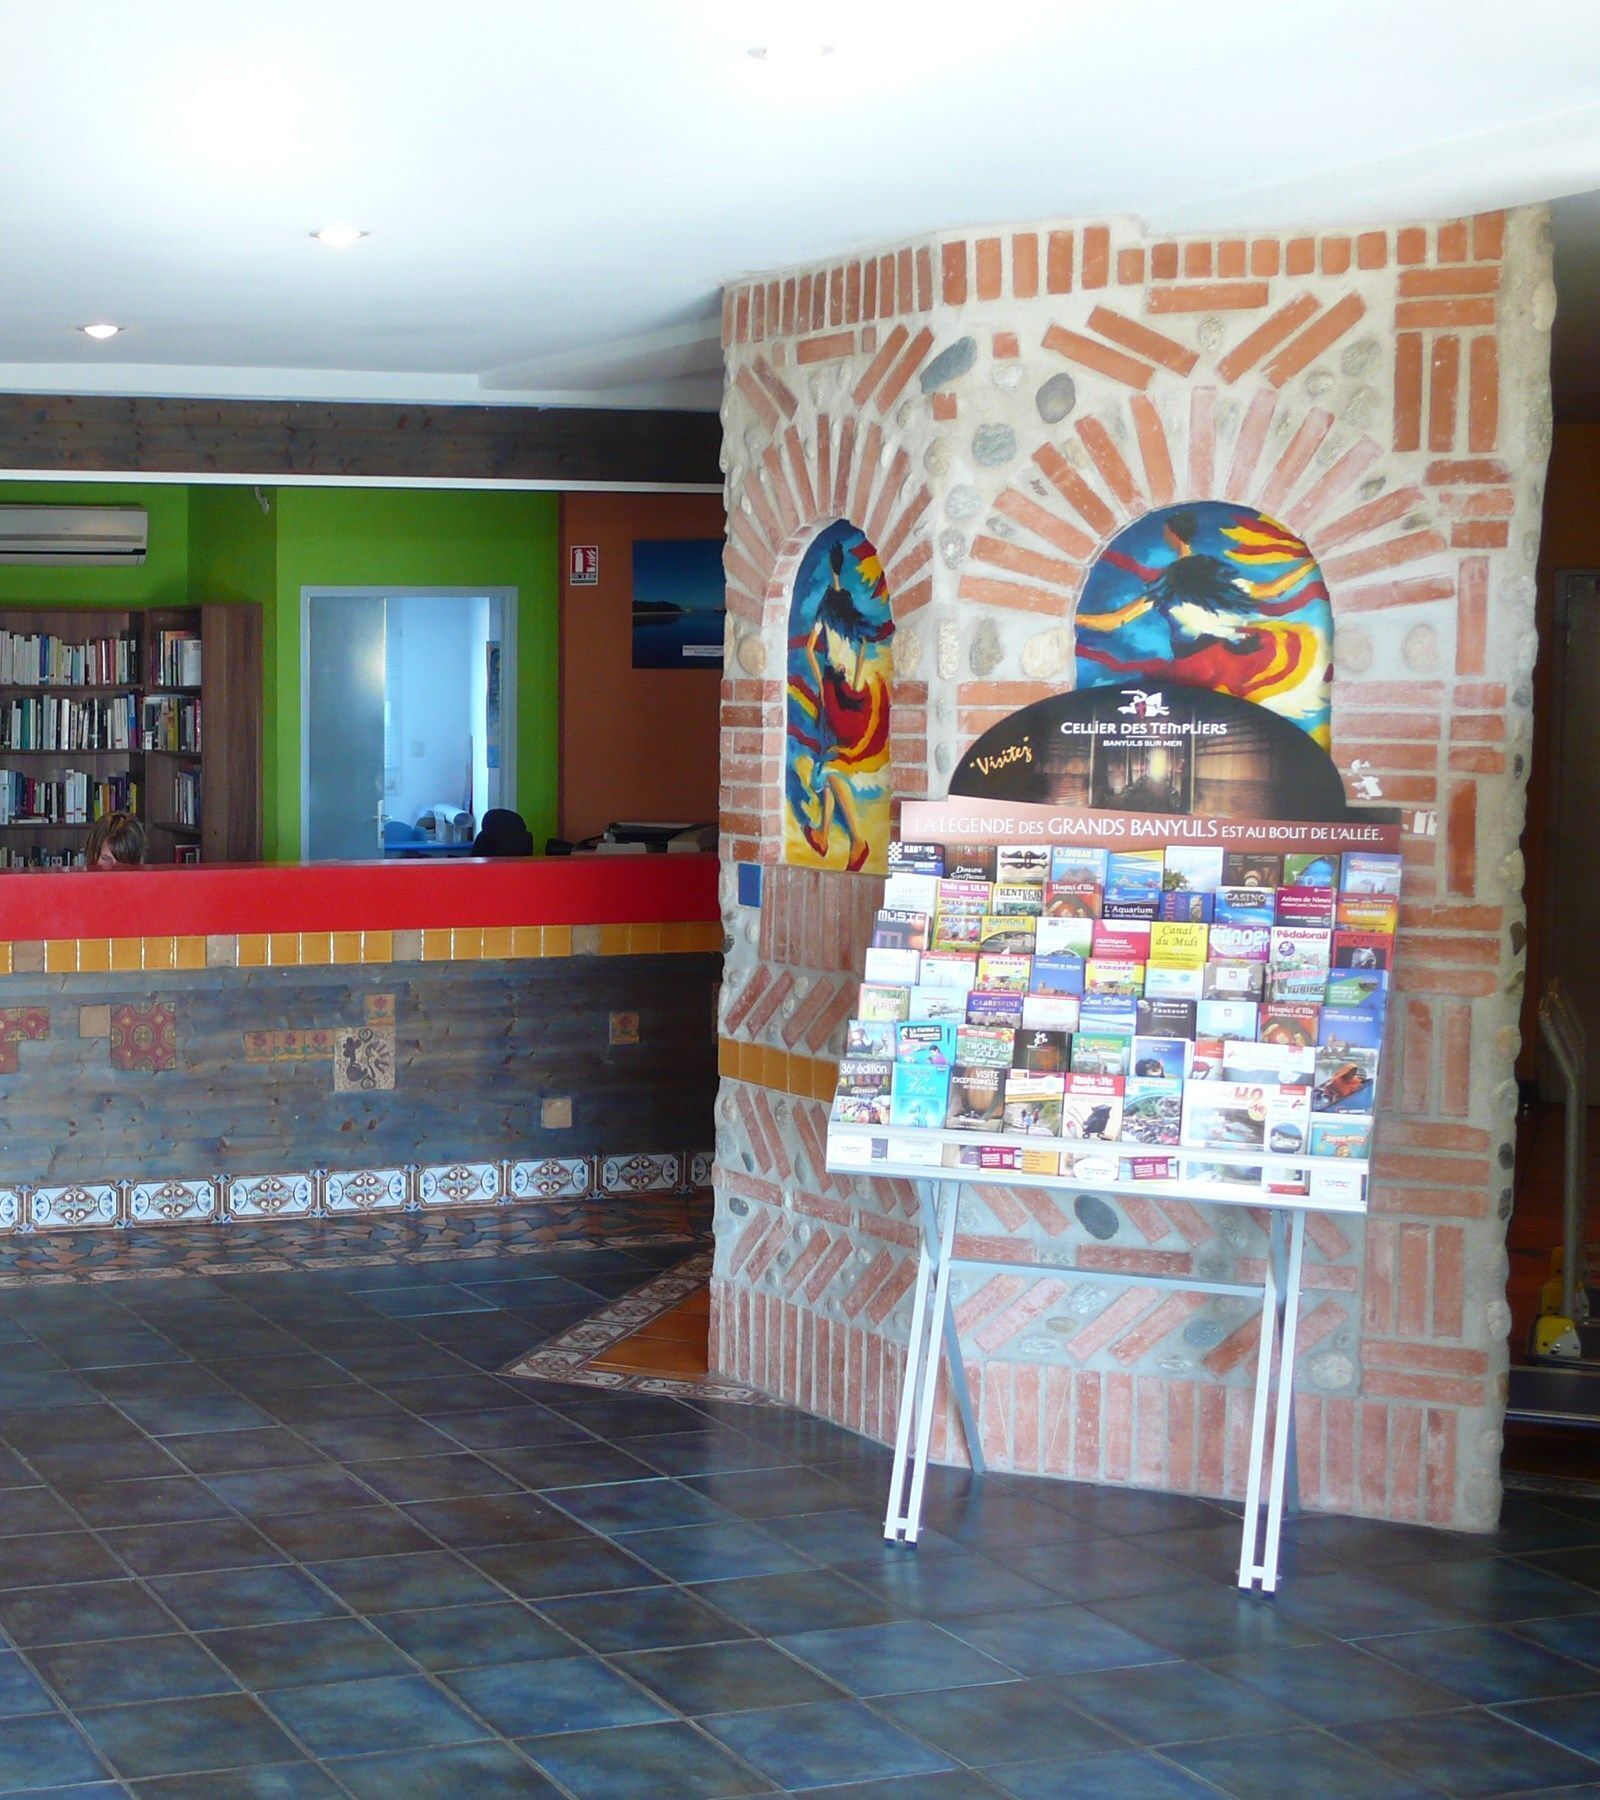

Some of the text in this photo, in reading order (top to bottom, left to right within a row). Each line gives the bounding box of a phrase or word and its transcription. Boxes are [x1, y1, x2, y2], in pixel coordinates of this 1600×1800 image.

[1120, 722, 1148, 735] DES
[1103, 739, 1143, 747] BANYULS
[1144, 739, 1162, 747] SUR
[915, 817, 938, 833] LA
[1019, 821, 1044, 835] DES
[1048, 817, 1125, 836] GRANDS
[1130, 819, 1217, 838] BANYULS
[1222, 824, 1245, 838] EST
[1246, 825, 1266, 838] AU
[1269, 825, 1308, 839] BOUT
[1310, 826, 1329, 840] DE
[1162, 926, 1193, 936] Canal
[1156, 937, 1198, 947] du Midi
